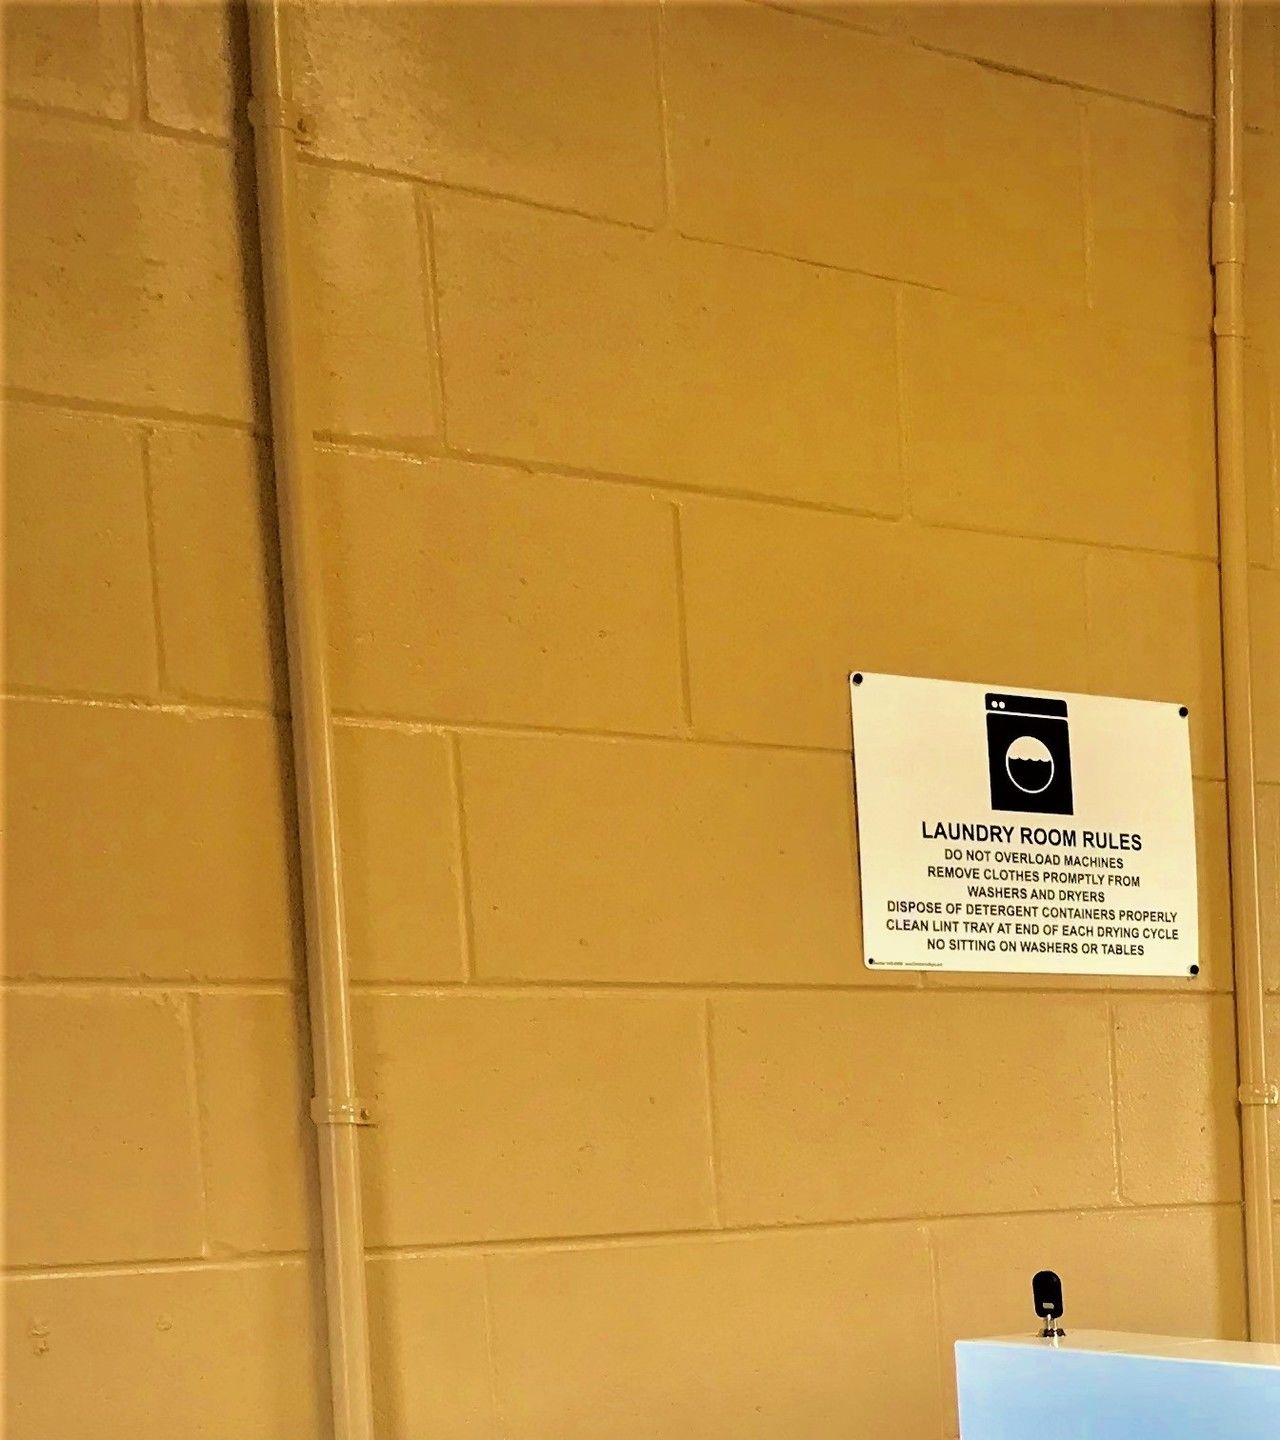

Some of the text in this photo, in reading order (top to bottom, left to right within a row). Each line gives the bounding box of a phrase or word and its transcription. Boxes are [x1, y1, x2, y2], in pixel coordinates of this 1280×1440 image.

[922, 821, 1142, 850] LAUNDRY ROOM RULES
[945, 849, 1123, 868] DO NOT OVERLOAD MACHINES
[928, 867, 1140, 886] REMOVE CLOTHES PROMPTLY FROM
[968, 886, 1104, 902] WASHERS AND DRYERS
[888, 901, 1177, 922] DISPOSE OF DETERGENT CONTAINERS PROPERLY
[887, 919, 1178, 940] CLEAN LINT TRAY AT END OF EACH DRYING CYCLE
[928, 939, 1143, 955] NO SITTING ON WASHERS OR TABLES
